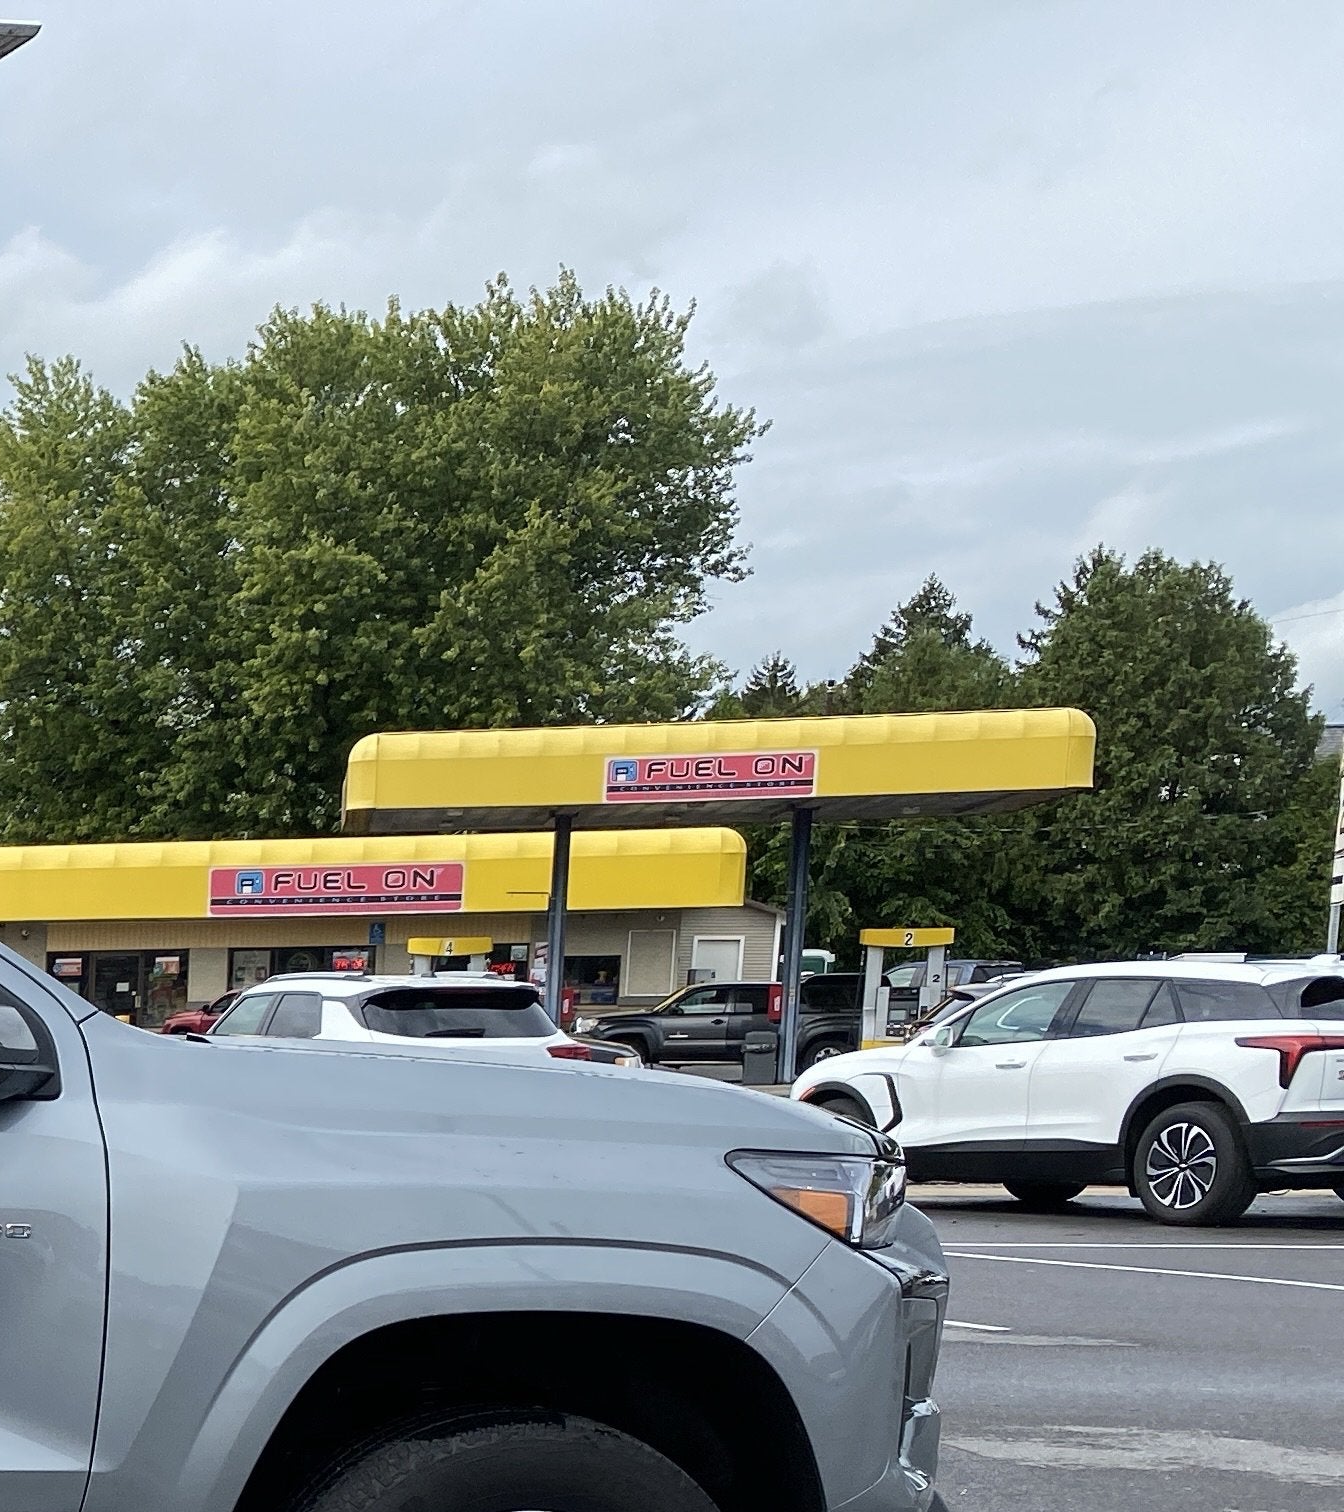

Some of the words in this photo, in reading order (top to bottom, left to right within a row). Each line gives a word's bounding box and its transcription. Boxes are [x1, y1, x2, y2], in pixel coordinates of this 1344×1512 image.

[646, 759, 736, 779] FUEL
[754, 756, 804, 775] ON
[619, 782, 735, 792] CONVENIENCE
[746, 780, 796, 788] STORE
[273, 872, 366, 892] FUEL
[384, 869, 435, 888] ON
[226, 896, 367, 905] CONVENIENCE
[380, 894, 441, 902] STORE
[905, 932, 913, 946] 2
[445, 941, 454, 955] 4
[932, 974, 940, 982] 2
